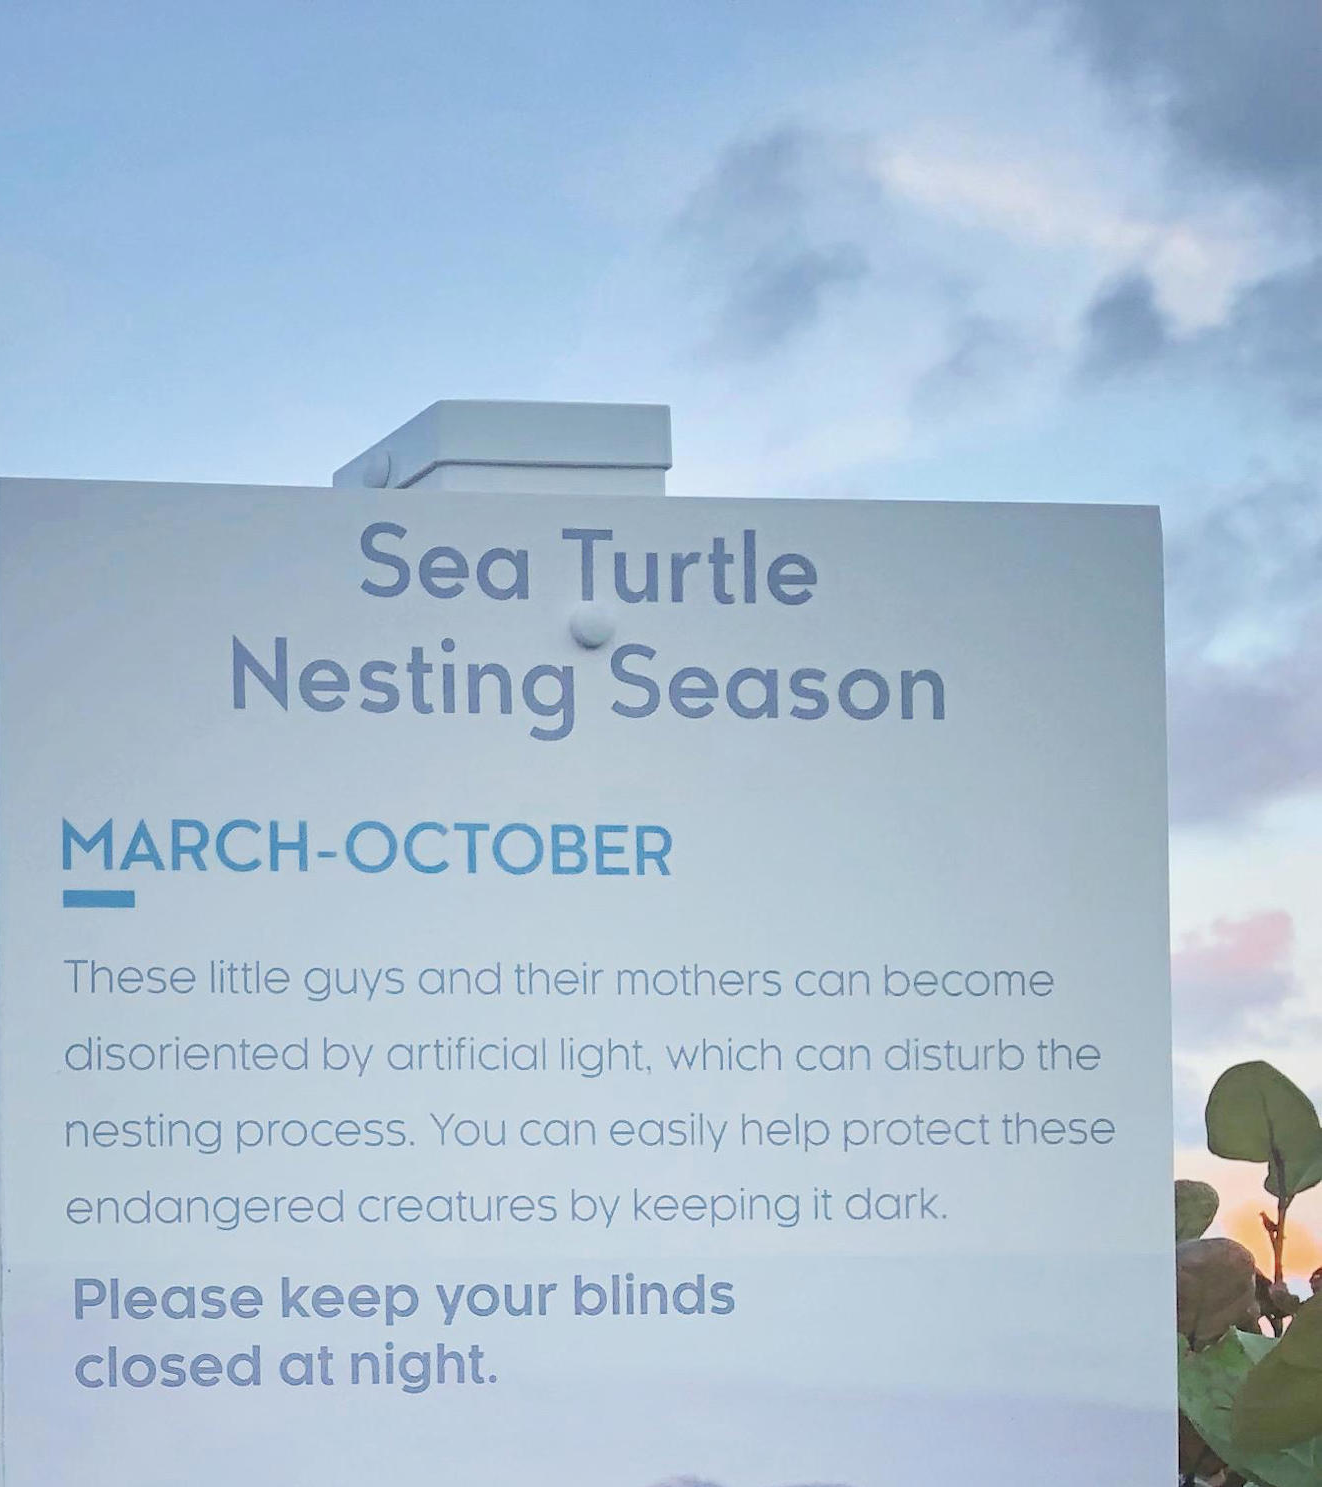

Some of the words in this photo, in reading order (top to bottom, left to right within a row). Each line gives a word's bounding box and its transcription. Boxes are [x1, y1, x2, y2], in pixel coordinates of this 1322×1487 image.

[360, 522, 528, 600] Sea
[562, 528, 817, 605] Turtle
[233, 635, 576, 741] Nesting
[611, 644, 945, 720] Season
[63, 819, 672, 875] MARCH-OCTOBER
[64, 960, 196, 994] These
[211, 960, 290, 994] little
[304, 968, 404, 1002] guys
[419, 962, 500, 995] and
[514, 962, 603, 996] their
[618, 964, 781, 997] mothers
[795, 970, 870, 997] can
[884, 965, 1054, 997] become
[65, 1036, 308, 1071] disoriented
[324, 1037, 373, 1077] by
[388, 1037, 546, 1071] artificial
[561, 1038, 651, 1078] light,
[666, 1038, 781, 1071] which
[796, 1045, 870, 1071] can
[885, 1038, 1024, 1071] disturb
[1037, 1039, 1101, 1070] the
[66, 1113, 221, 1154] nesting
[237, 1120, 416, 1154] process.
[430, 1113, 505, 1146] You
[520, 1120, 596, 1146] can
[610, 1113, 727, 1152] easily
[742, 1113, 830, 1152] help
[844, 1115, 989, 1152] protect
[1002, 1112, 1115, 1145] these
[67, 1190, 343, 1231] endangered
[358, 1191, 557, 1222] creatures
[572, 1189, 620, 1228] by
[634, 1188, 799, 1228] keeping
[814, 1186, 832, 1220] it
[846, 1187, 947, 1220] dark.
[75, 1278, 263, 1320] Please
[282, 1277, 419, 1326] keep
[436, 1283, 557, 1325] your
[574, 1273, 735, 1316] blinds
[75, 1345, 261, 1388] closed
[279, 1346, 334, 1386] at
[351, 1342, 497, 1394] night.
